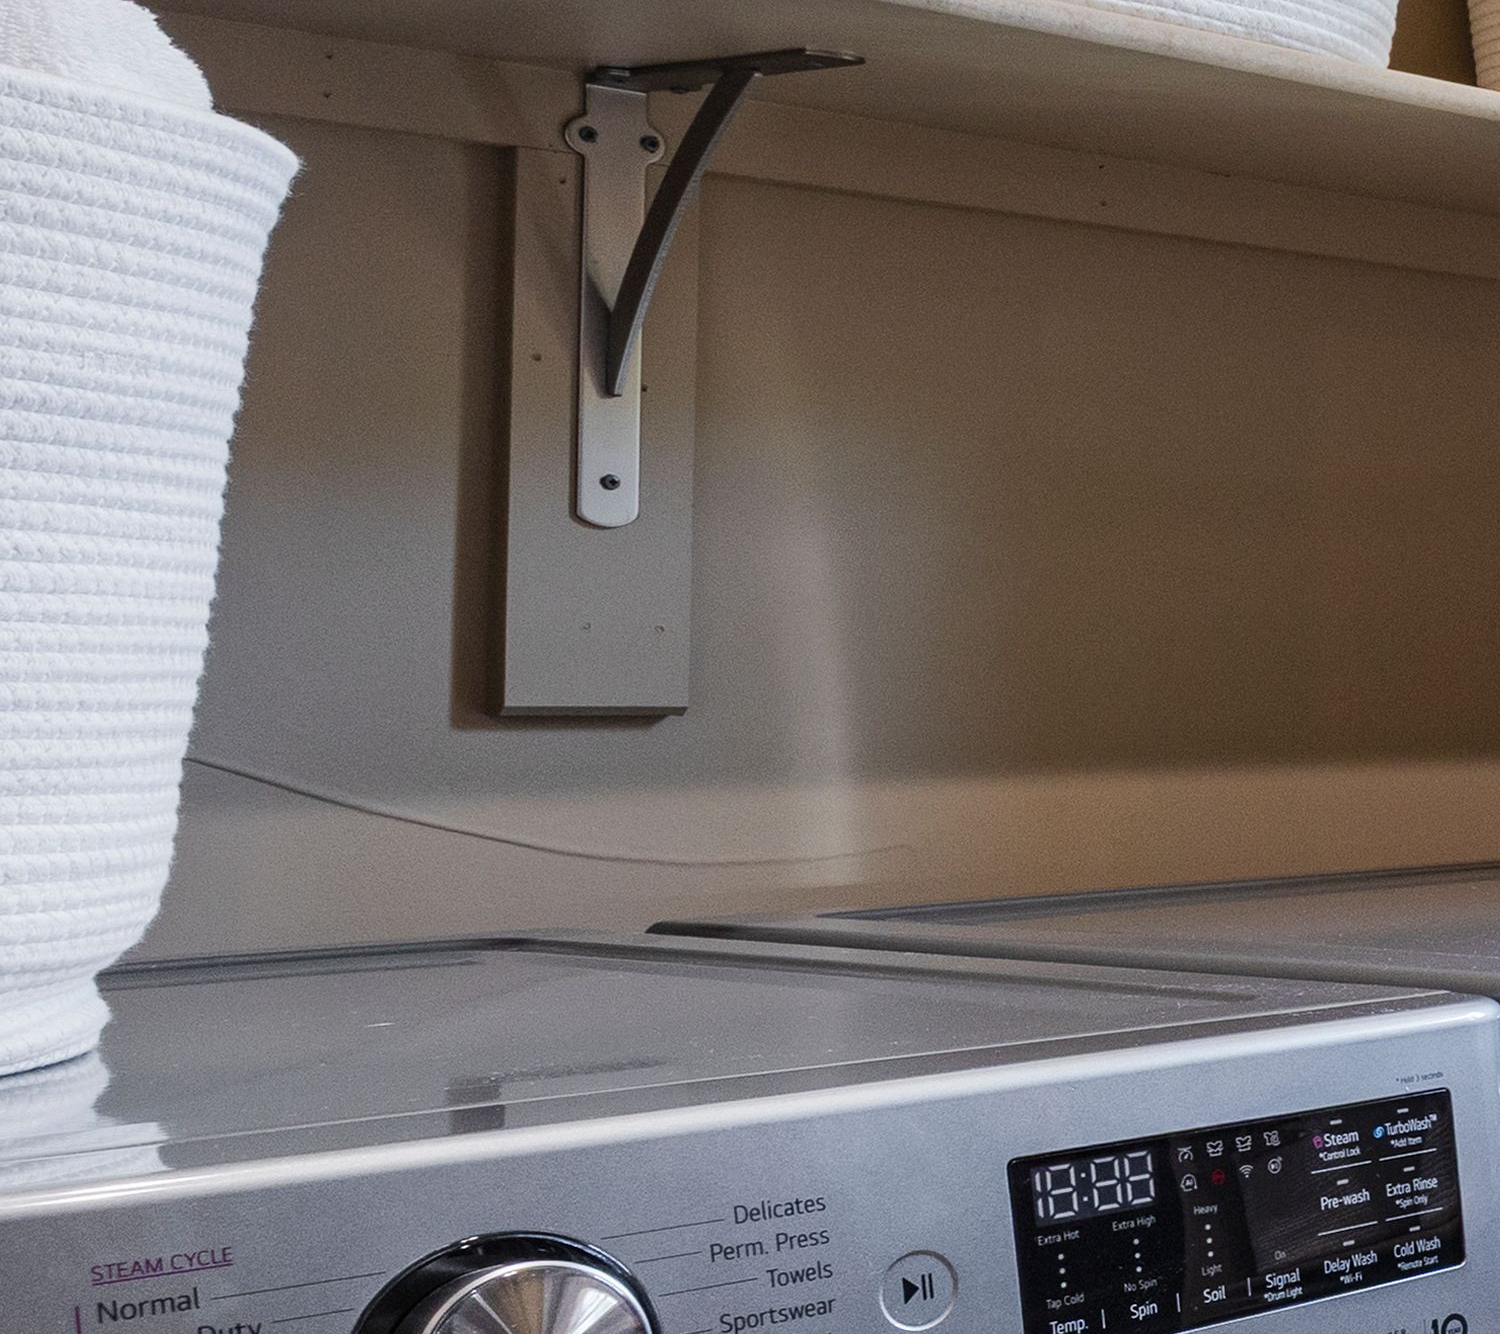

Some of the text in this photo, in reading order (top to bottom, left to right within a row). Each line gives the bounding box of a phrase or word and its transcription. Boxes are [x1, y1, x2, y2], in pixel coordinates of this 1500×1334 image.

[1324, 1131, 1359, 1147] Steam
[1346, 1146, 1361, 1157] Lock
[1386, 1177, 1438, 1198] Extra Rinse
[733, 1196, 826, 1225] Delicates
[1194, 1203, 1218, 1216] Heavy
[1320, 1189, 1370, 1211] Pre-wash
[1112, 1215, 1156, 1231] Extra High
[710, 1229, 830, 1263] Perm. Press
[1037, 1229, 1080, 1247] Extra Hot
[1394, 1236, 1441, 1258] Cold Wash
[91, 1246, 233, 1283] STEAM CYCLE
[1201, 1263, 1223, 1277] Light
[1324, 1250, 1378, 1274] Delay Wash
[766, 1261, 834, 1288] Towels
[1266, 1267, 1300, 1290] Signal
[1124, 1278, 1158, 1293] No Spin
[1203, 1285, 1226, 1304] Soil
[97, 1287, 201, 1324] Normal
[1046, 1293, 1085, 1310] Tap Cold
[1130, 1300, 1158, 1321] Spin
